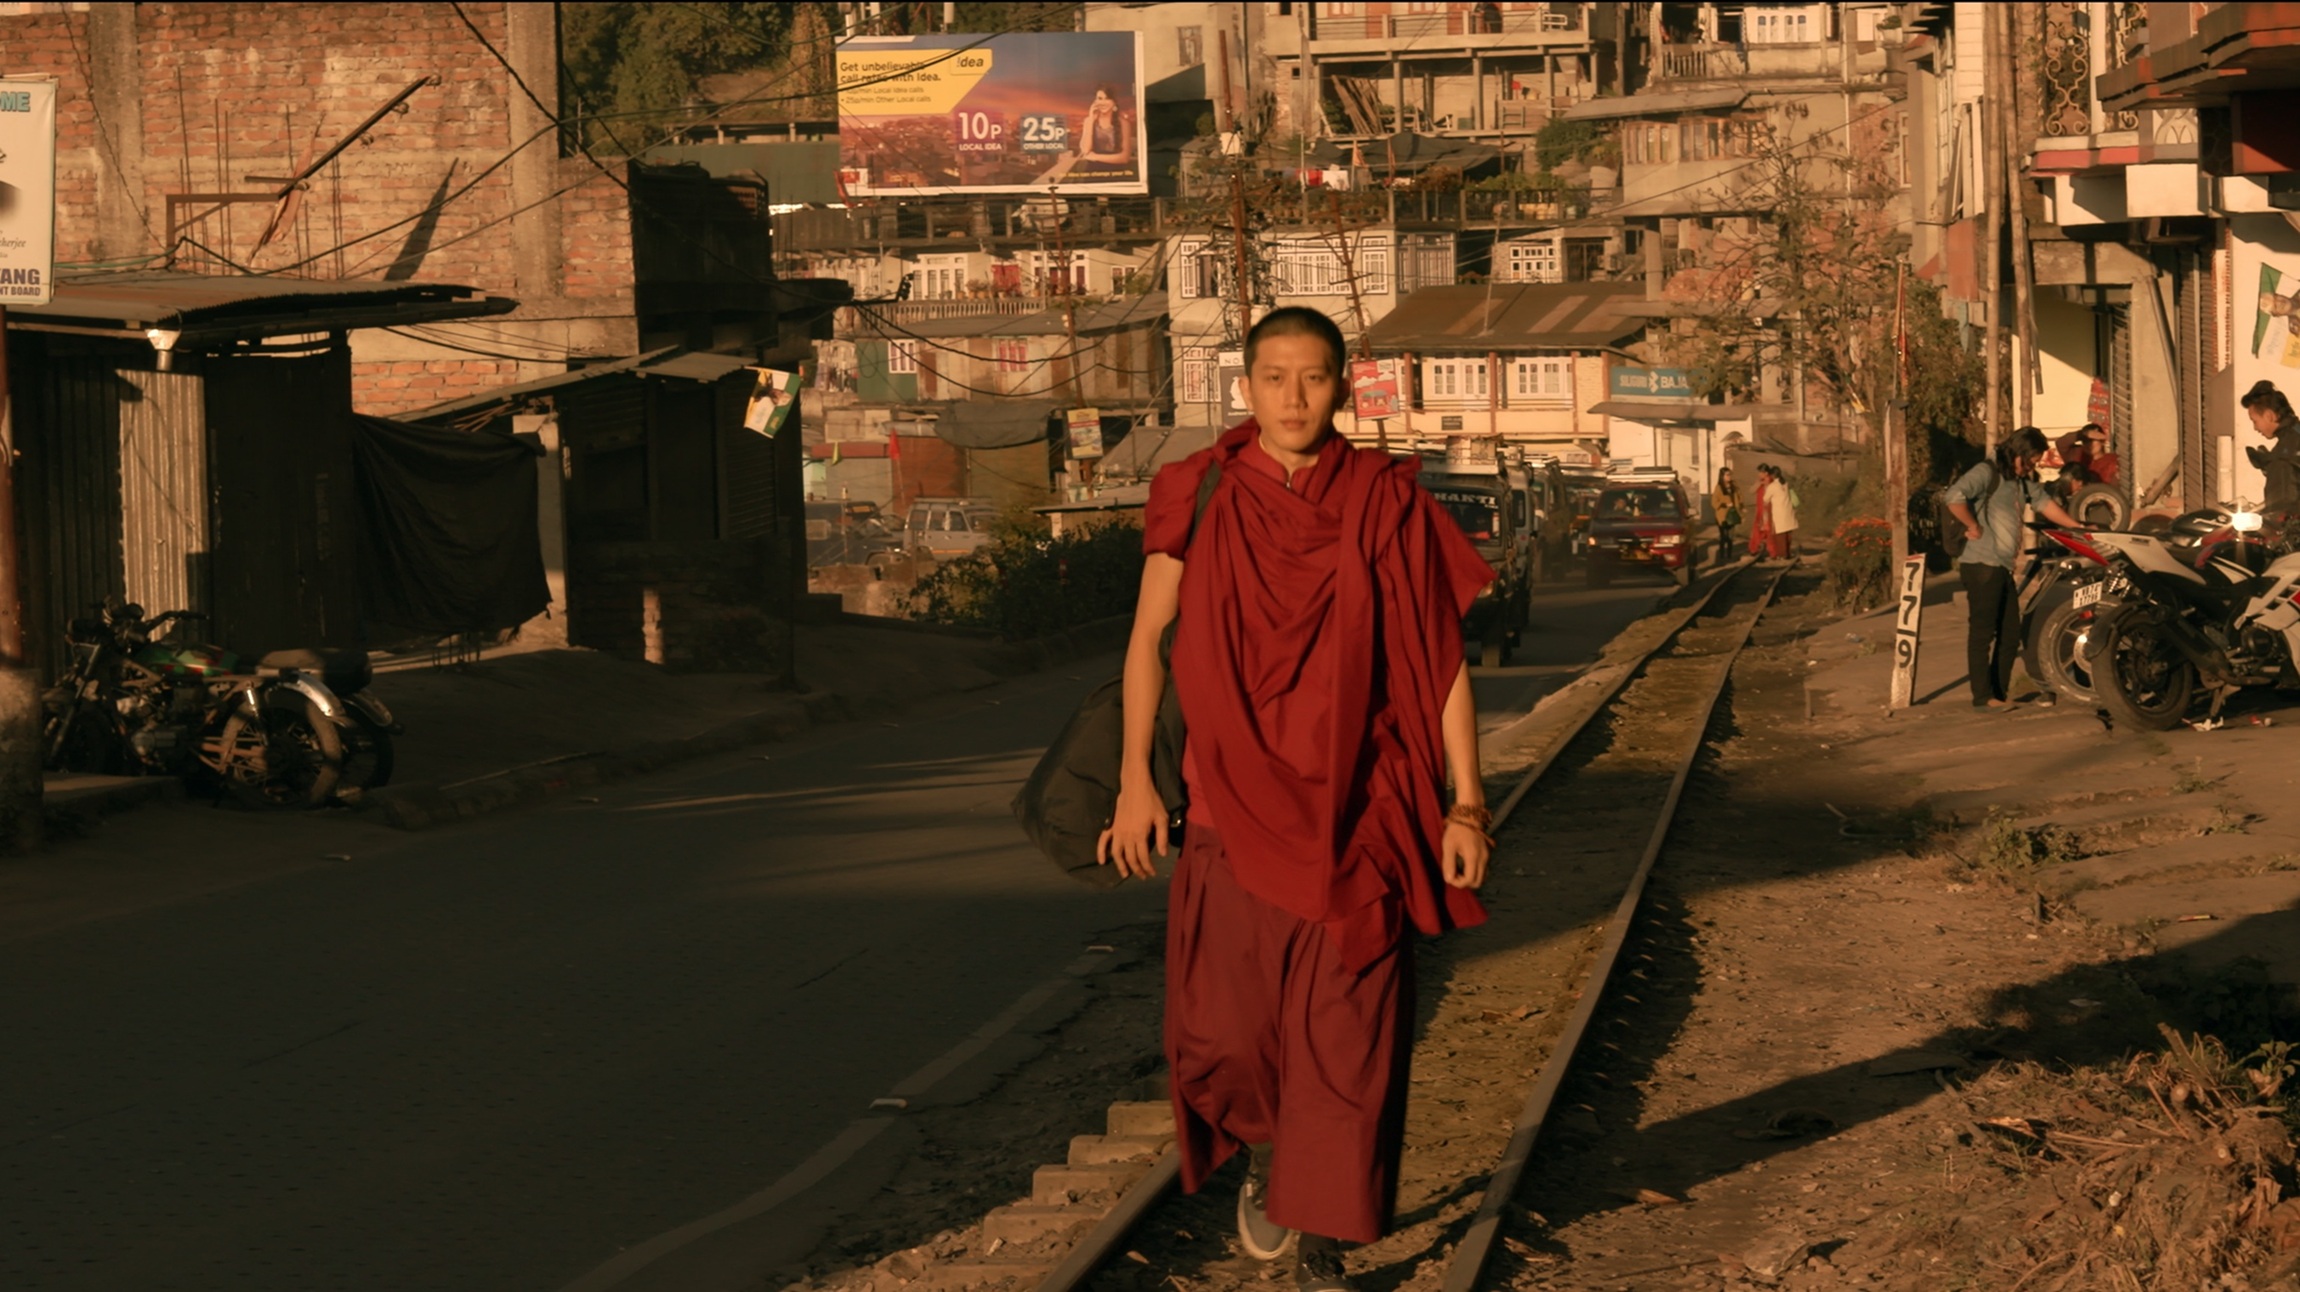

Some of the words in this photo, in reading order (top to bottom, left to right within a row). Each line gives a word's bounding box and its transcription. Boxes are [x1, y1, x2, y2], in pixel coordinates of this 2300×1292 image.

[840, 62, 859, 72] Get
[840, 74, 858, 83] call
[0, 91, 31, 112] ME
[959, 143, 984, 151] LOCAL
[985, 143, 1002, 151] IDEA
[0, 268, 40, 285] ANG
[11, 286, 41, 297] BOARD
[1661, 376, 1690, 389] BAJA
[1433, 493, 1496, 506] HAKTI
